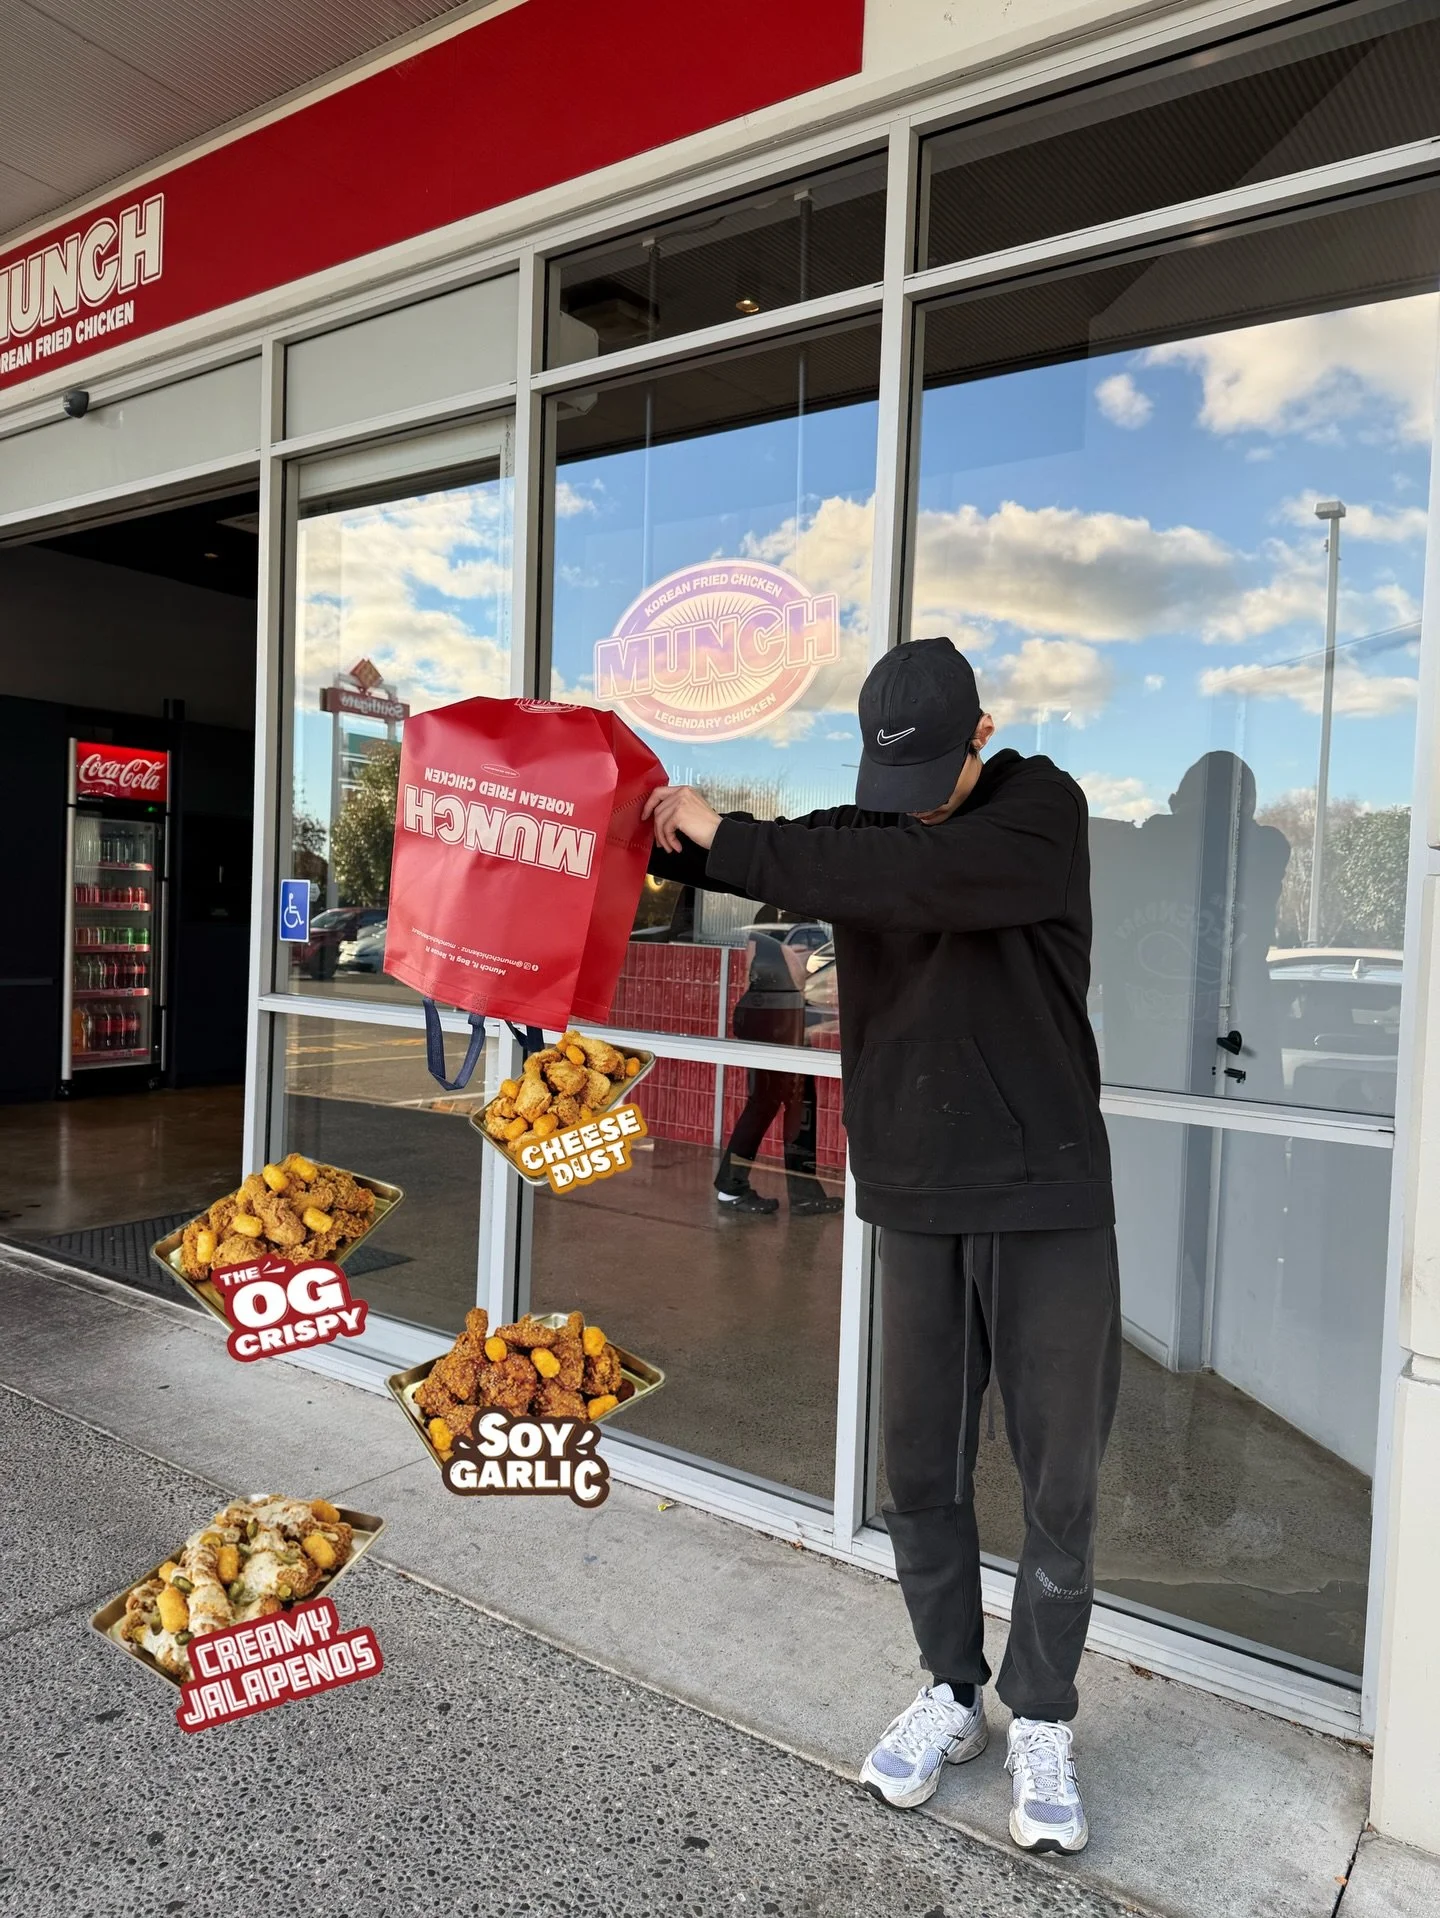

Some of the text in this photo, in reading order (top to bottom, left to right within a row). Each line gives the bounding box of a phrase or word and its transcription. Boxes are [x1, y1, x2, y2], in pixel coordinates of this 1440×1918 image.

[0, 192, 164, 344] UNCH
[0, 300, 134, 374] REAN FRIED CHICKEN
[644, 574, 783, 617] KOREAN FRIED CHICKEN
[593, 592, 840, 702] MUNCH
[654, 692, 777, 729] LEGENDARY CHICKEN
[79, 753, 165, 790] Coca-Cola
[424, 767, 476, 791] CHICKEN
[479, 781, 517, 802] FRIED
[519, 790, 575, 816] KOREAN
[404, 784, 596, 879] MUNCH
[456, 955, 471, 967] Bag
[479, 963, 507, 976] Munch
